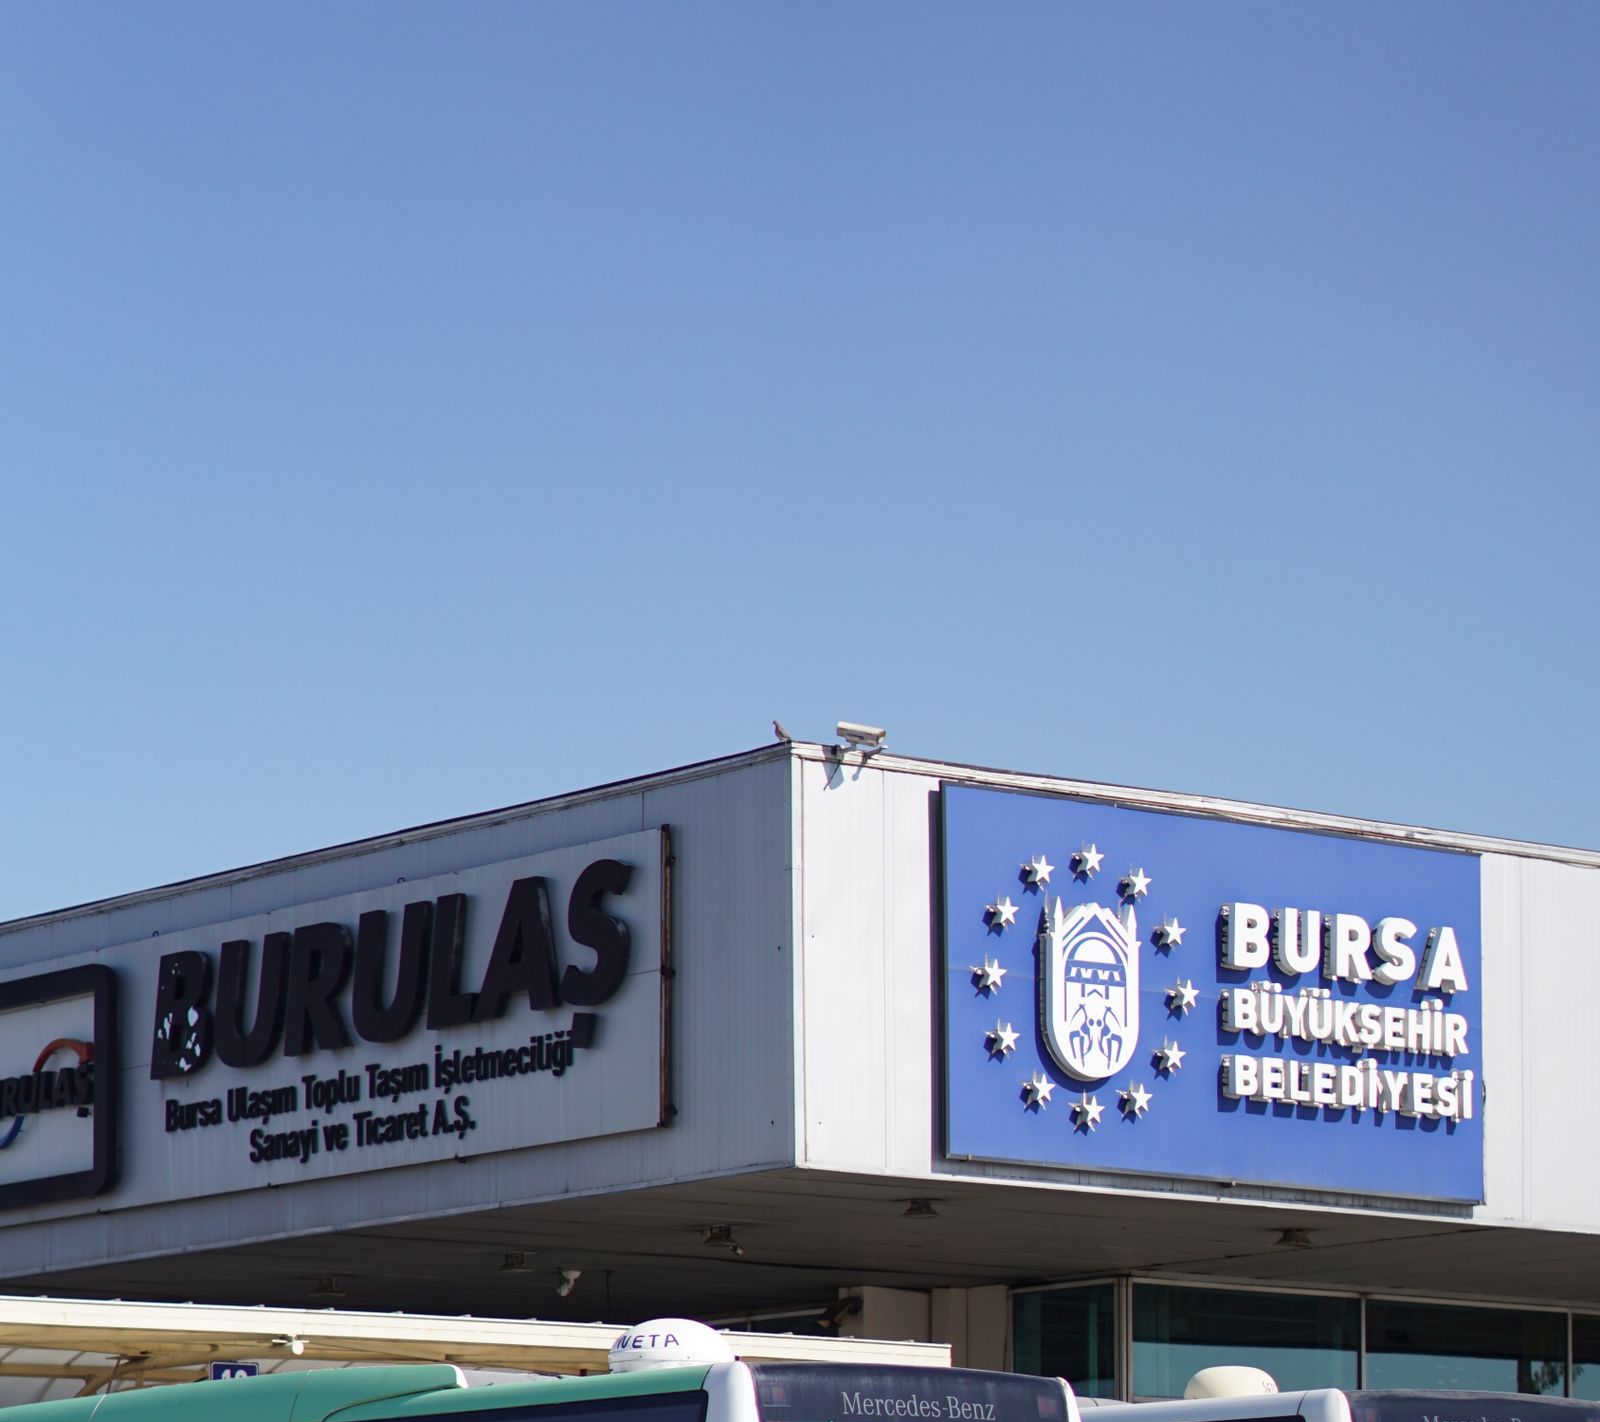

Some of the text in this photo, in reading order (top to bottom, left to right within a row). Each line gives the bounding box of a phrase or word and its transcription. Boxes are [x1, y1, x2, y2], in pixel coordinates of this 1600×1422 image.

[150, 858, 634, 1081] BURULAŞ
[1220, 901, 1470, 994] BURSA
[1221, 980, 1470, 1058] BÜYÜKŞEHİR
[0, 1064, 94, 1118] RULAŞ
[165, 1029, 574, 1132] Bursa Ulaşım Toplu Taşım İşletmeciliği
[1222, 1053, 1474, 1123] BELEDİYESİ
[249, 1119, 318, 1164] Sanayi
[323, 1126, 349, 1151] ve
[432, 1096, 475, 1139] A.Ş.
[841, 1391, 997, 1421] Mercedes-Benz
